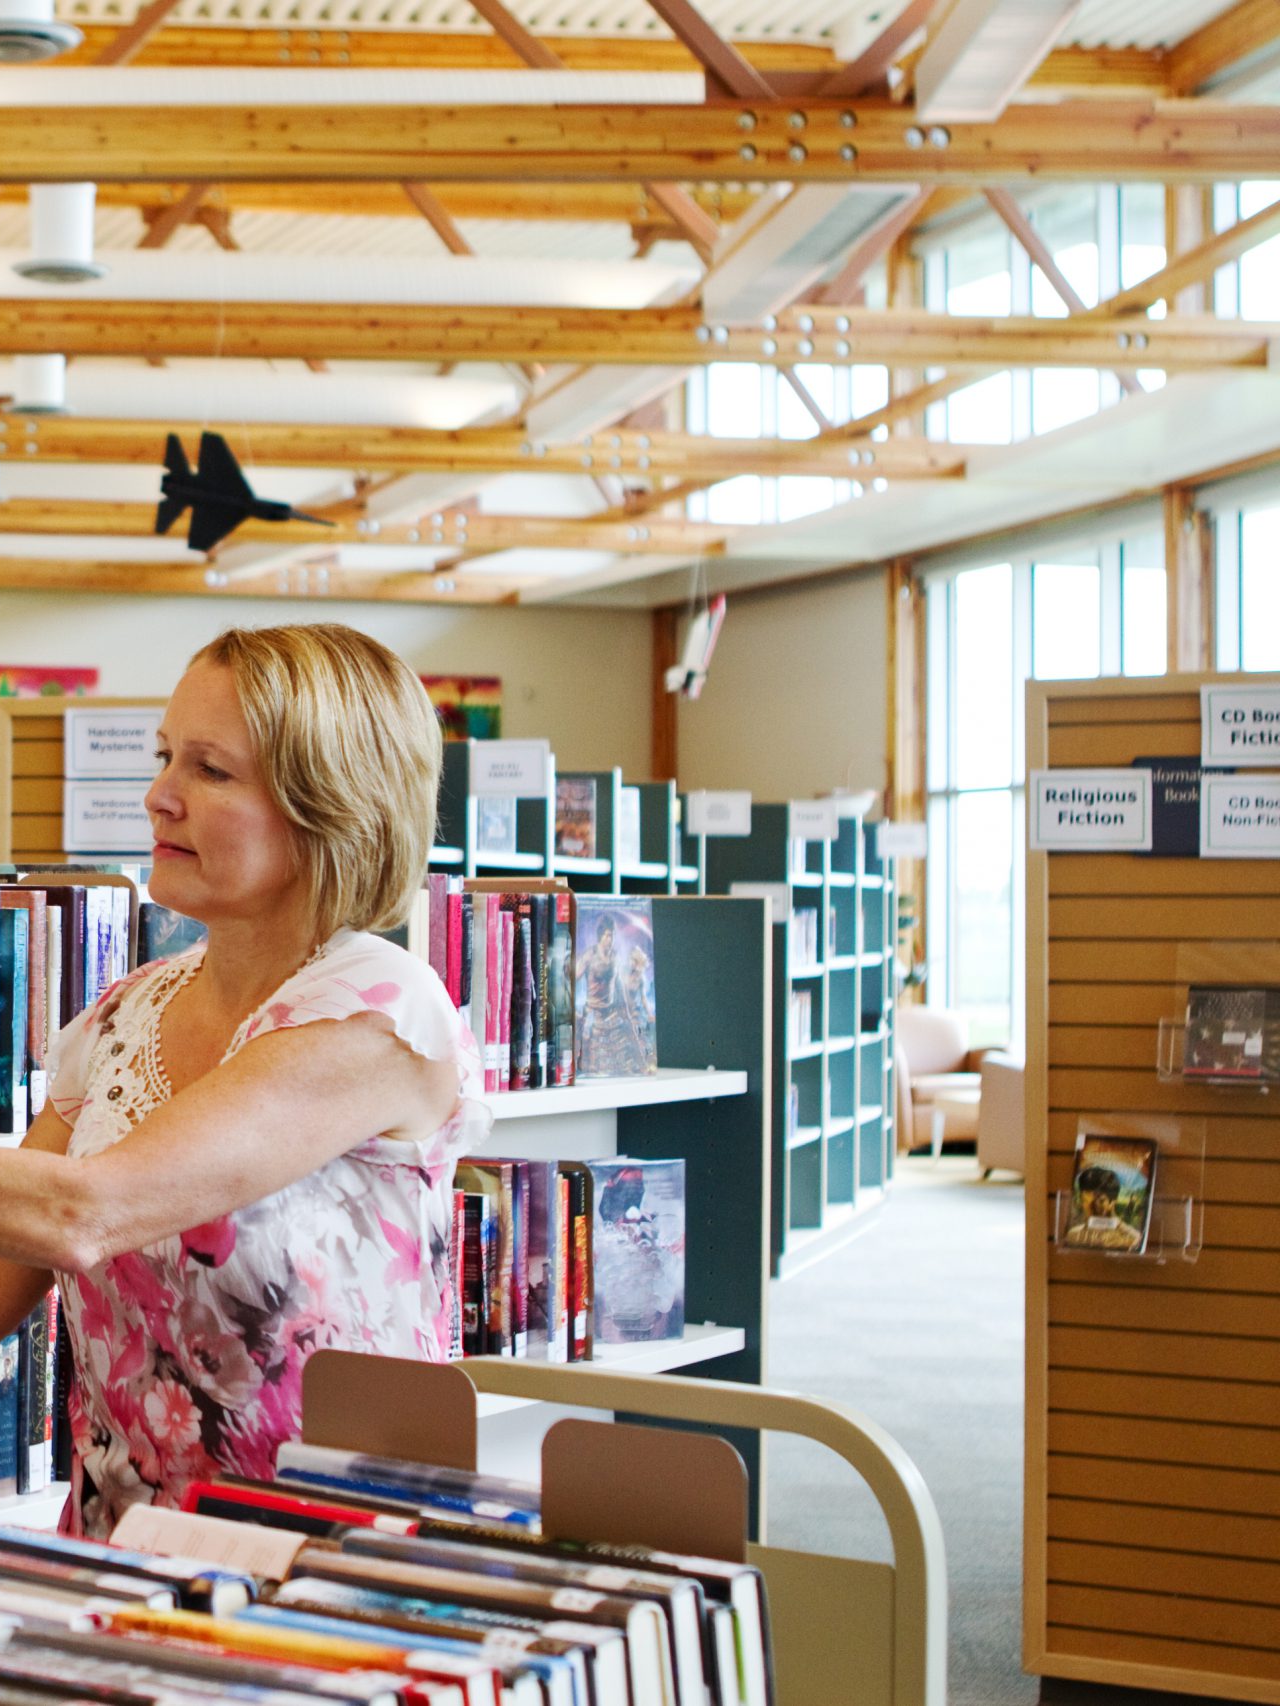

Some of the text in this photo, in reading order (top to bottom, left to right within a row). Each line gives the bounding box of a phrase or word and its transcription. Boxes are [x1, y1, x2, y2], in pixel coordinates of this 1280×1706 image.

[1221, 708, 1245, 723] CD
[87, 727, 146, 738] Hardcover
[89, 742, 144, 753] Mysteries
[1045, 788, 1137, 806] Religious
[1228, 797, 1250, 809] CD
[91, 799, 140, 808] Hardcover
[1057, 811, 1125, 825] Fiction
